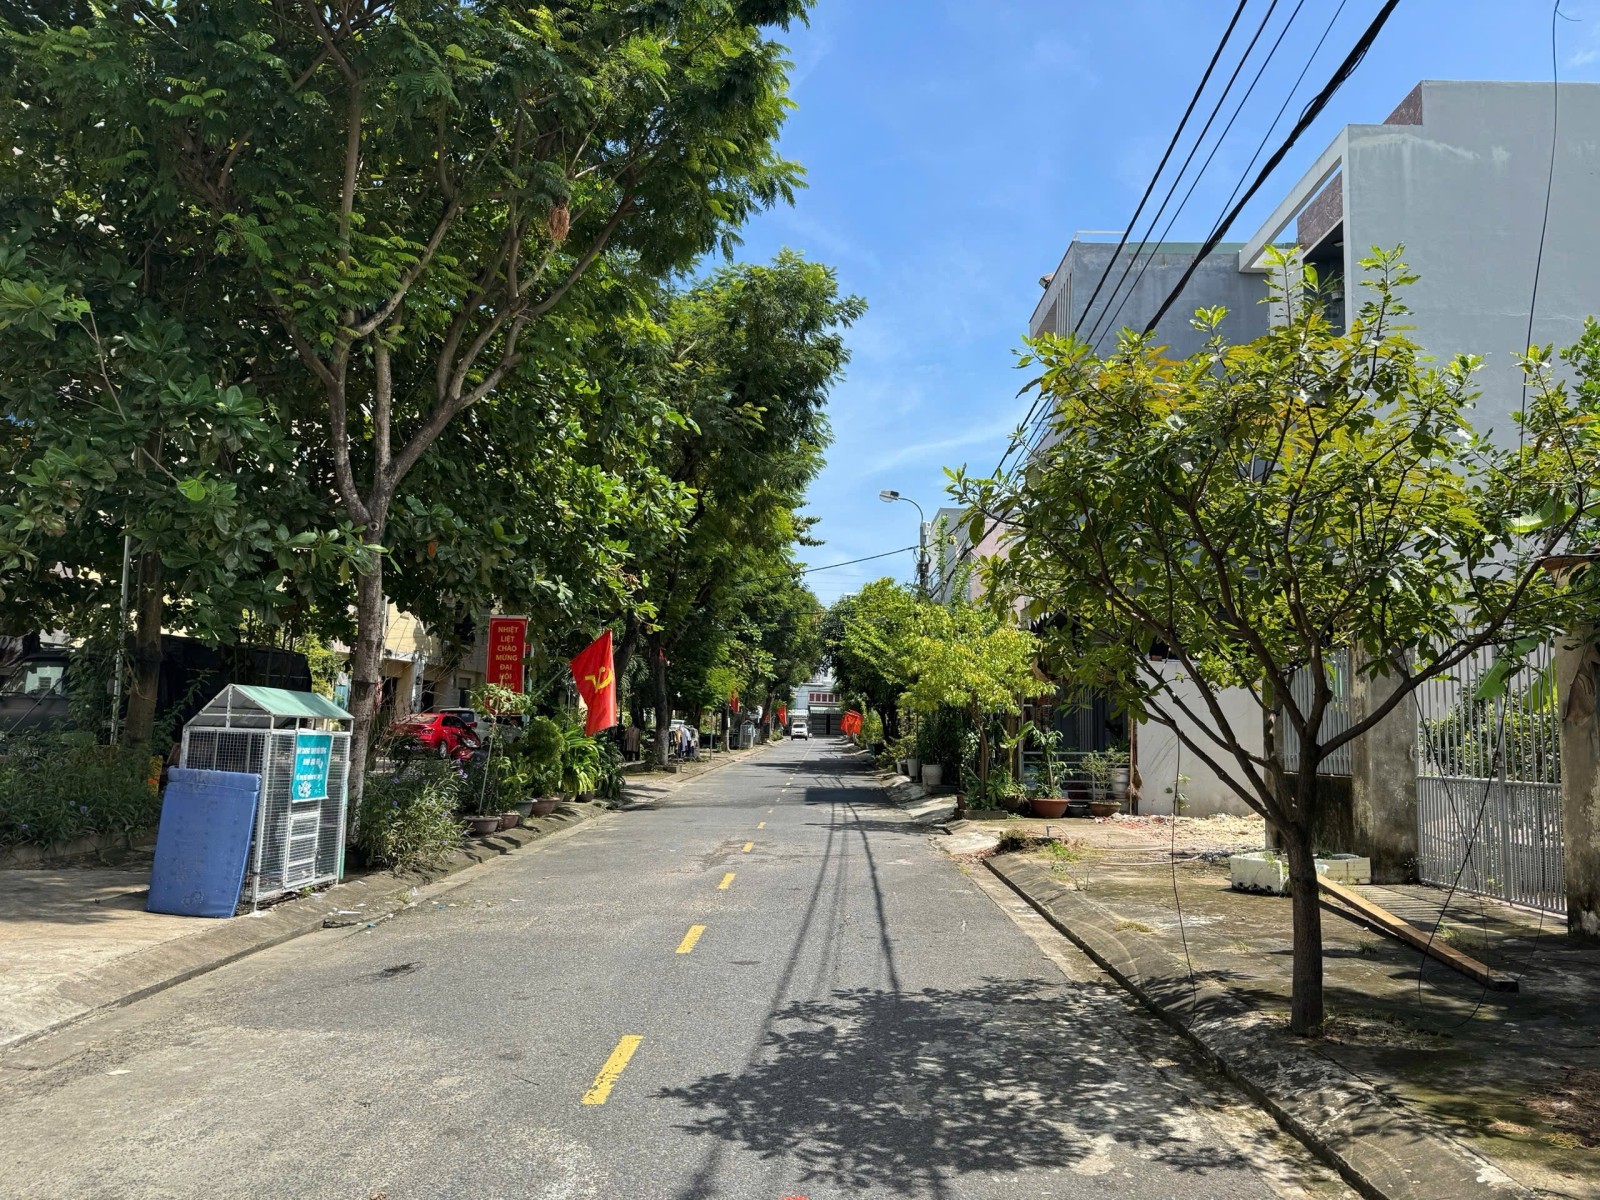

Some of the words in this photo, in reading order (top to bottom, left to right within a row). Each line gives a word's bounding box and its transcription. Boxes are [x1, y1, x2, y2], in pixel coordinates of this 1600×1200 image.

[498, 625, 519, 634] NHIỆT
[500, 635, 515, 643] LIỆT
[497, 643, 517, 652] CHÀO
[495, 653, 518, 661] MỪNG
